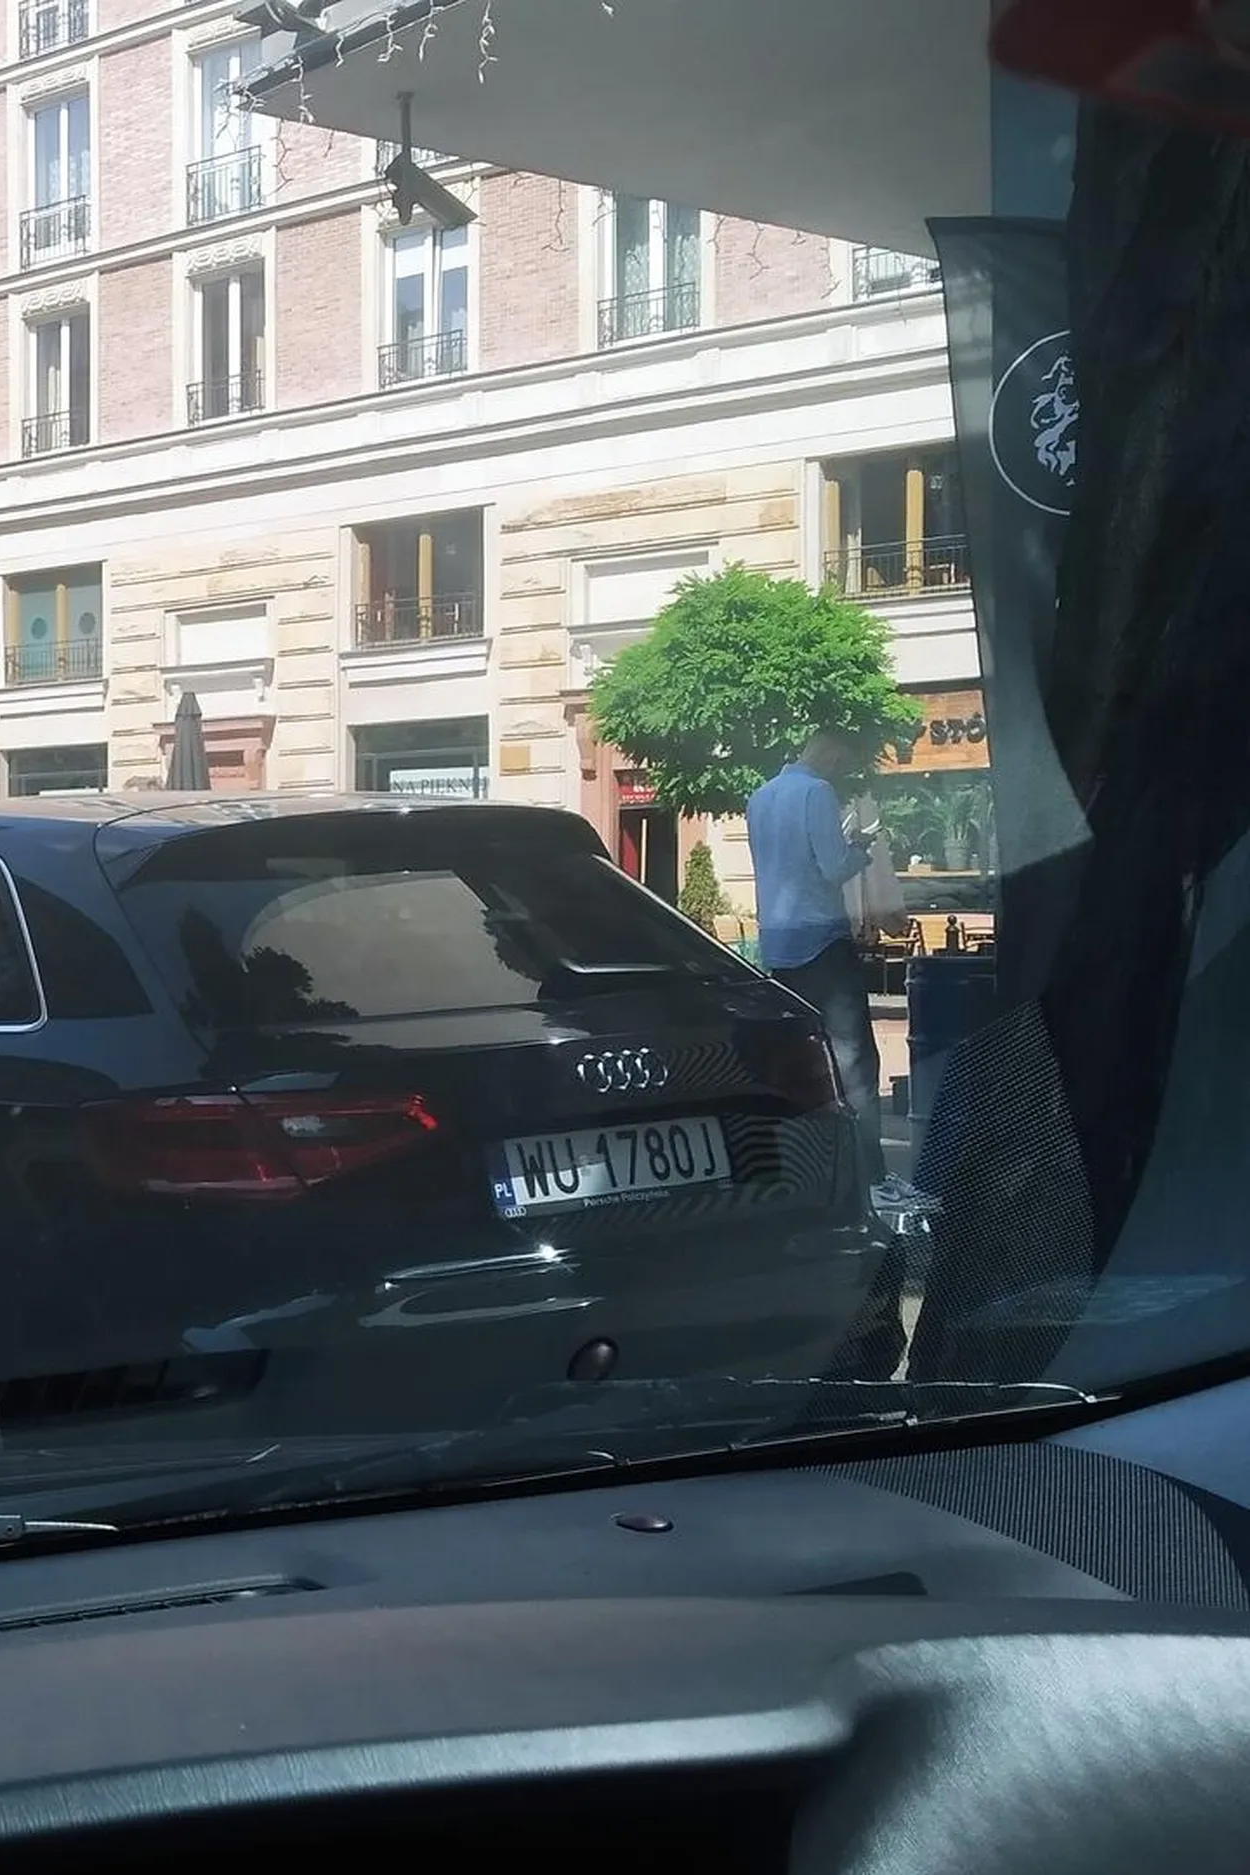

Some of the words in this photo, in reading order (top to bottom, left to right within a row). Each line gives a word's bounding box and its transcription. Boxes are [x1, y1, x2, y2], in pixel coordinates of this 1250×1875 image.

[515, 1137, 581, 1199] WU
[595, 1122, 717, 1189] 1780J
[494, 1182, 512, 1199] PL
